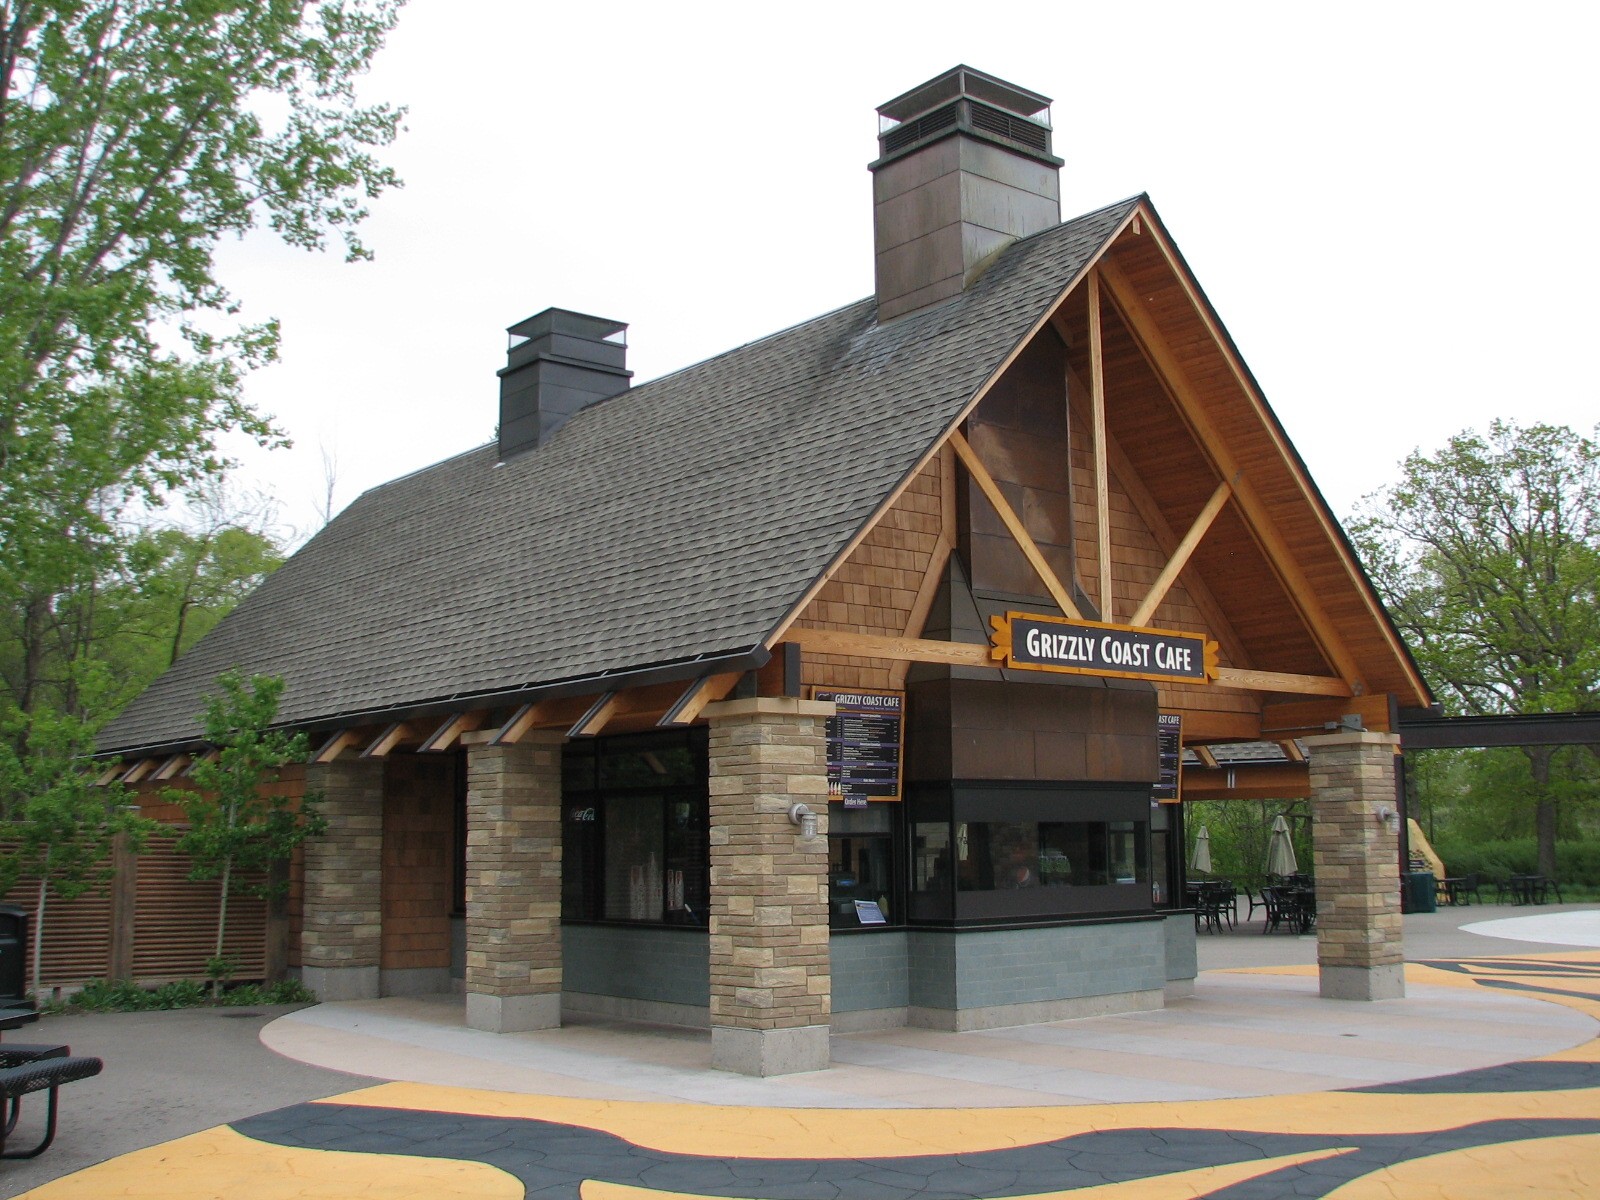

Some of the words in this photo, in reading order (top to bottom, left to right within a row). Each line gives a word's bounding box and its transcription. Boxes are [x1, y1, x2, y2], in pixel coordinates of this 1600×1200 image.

[1026, 628, 1095, 662] GRIZZLY
[1101, 636, 1150, 667] COAST
[1155, 642, 1192, 671] CAFE
[835, 694, 862, 705] GRIZZLY
[862, 695, 883, 706] COAST
[883, 697, 900, 707] CAFE
[1158, 715, 1168, 724] AST
[1168, 715, 1180, 725] CAFE
